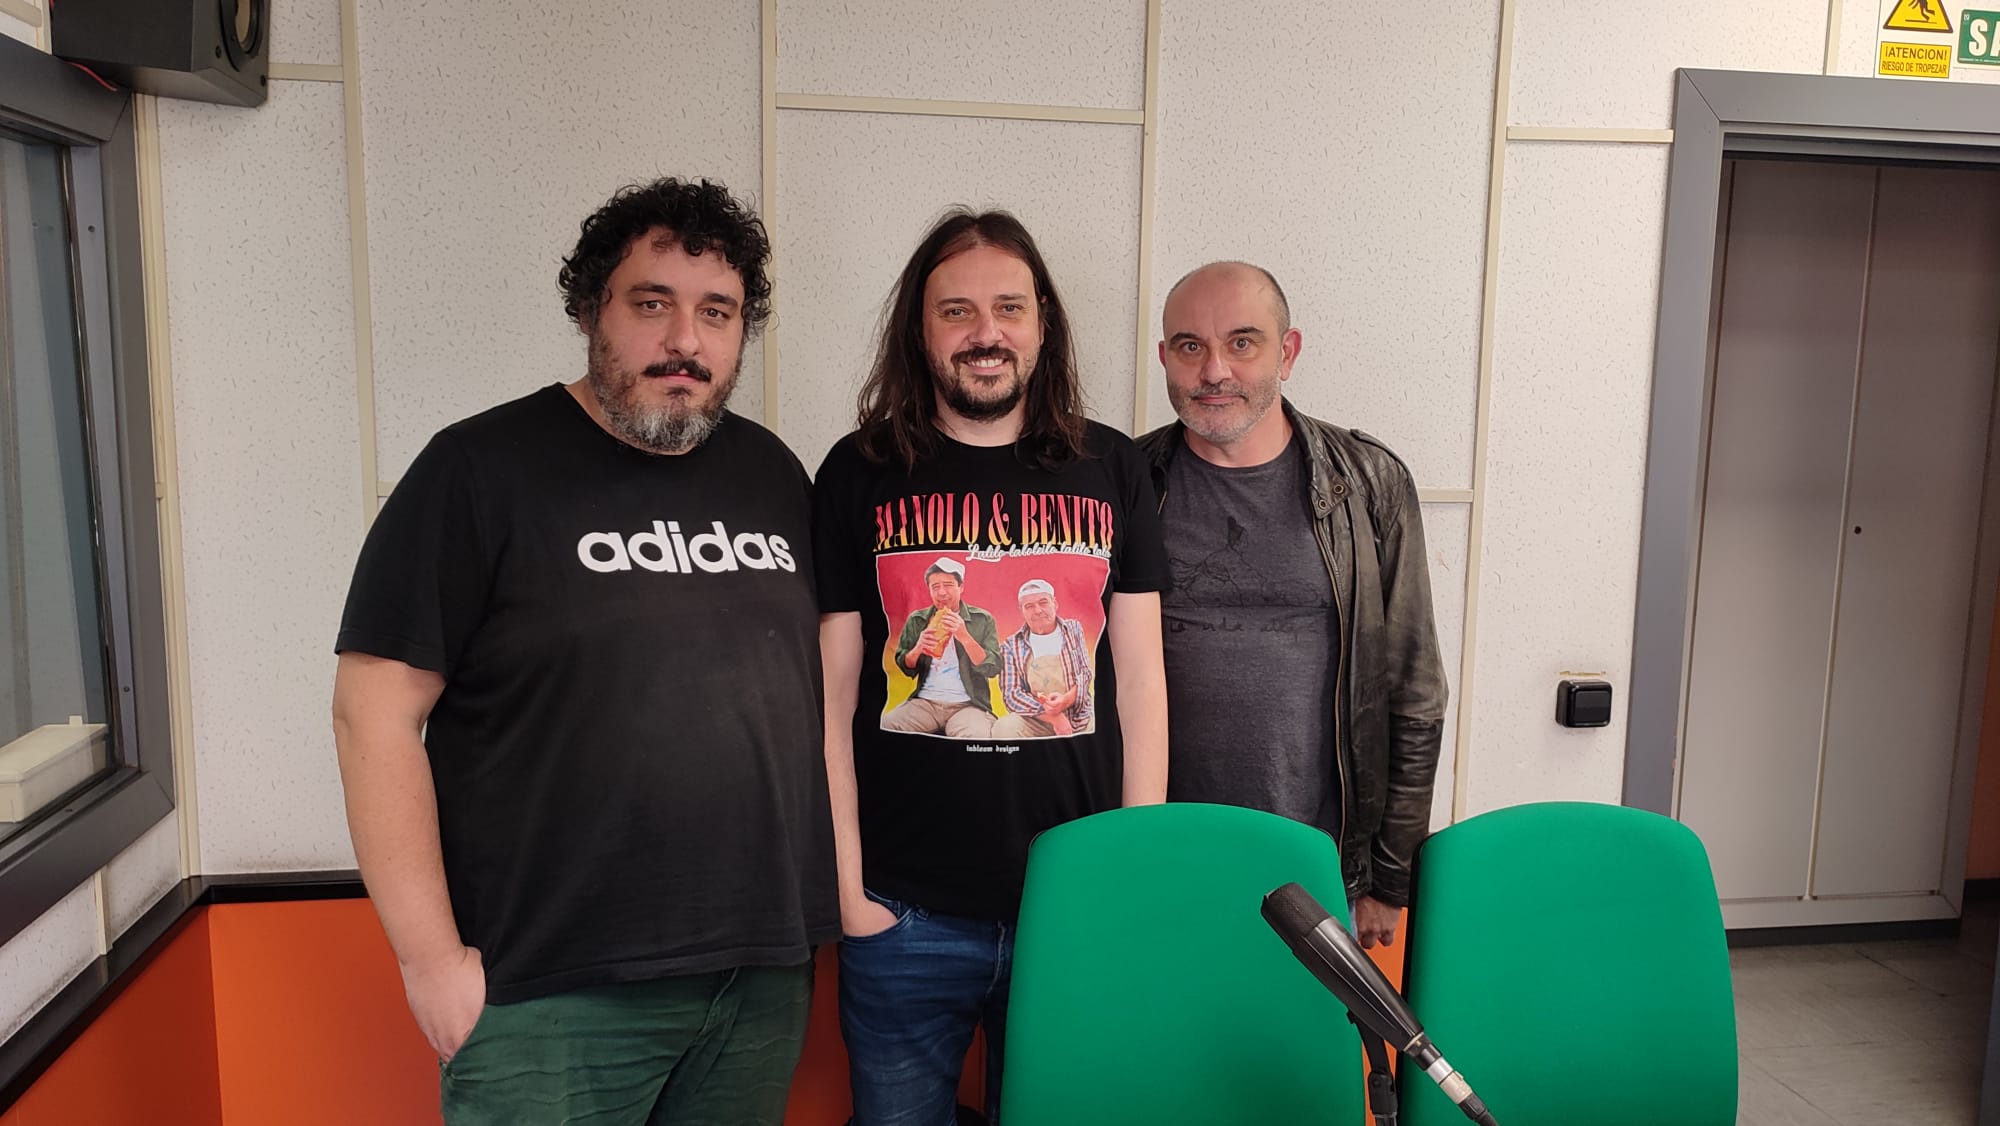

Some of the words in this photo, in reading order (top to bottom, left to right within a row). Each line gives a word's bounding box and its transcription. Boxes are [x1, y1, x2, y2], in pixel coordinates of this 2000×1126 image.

[1881, 60, 1905, 72] RIESGO
[1905, 62, 1914, 73] DE
[1915, 62, 1947, 75] TROPEZAR
[577, 520, 796, 573] adidas
[873, 492, 980, 552] MANOLO
[988, 492, 1012, 546] &
[1020, 493, 1114, 551] BENITO
